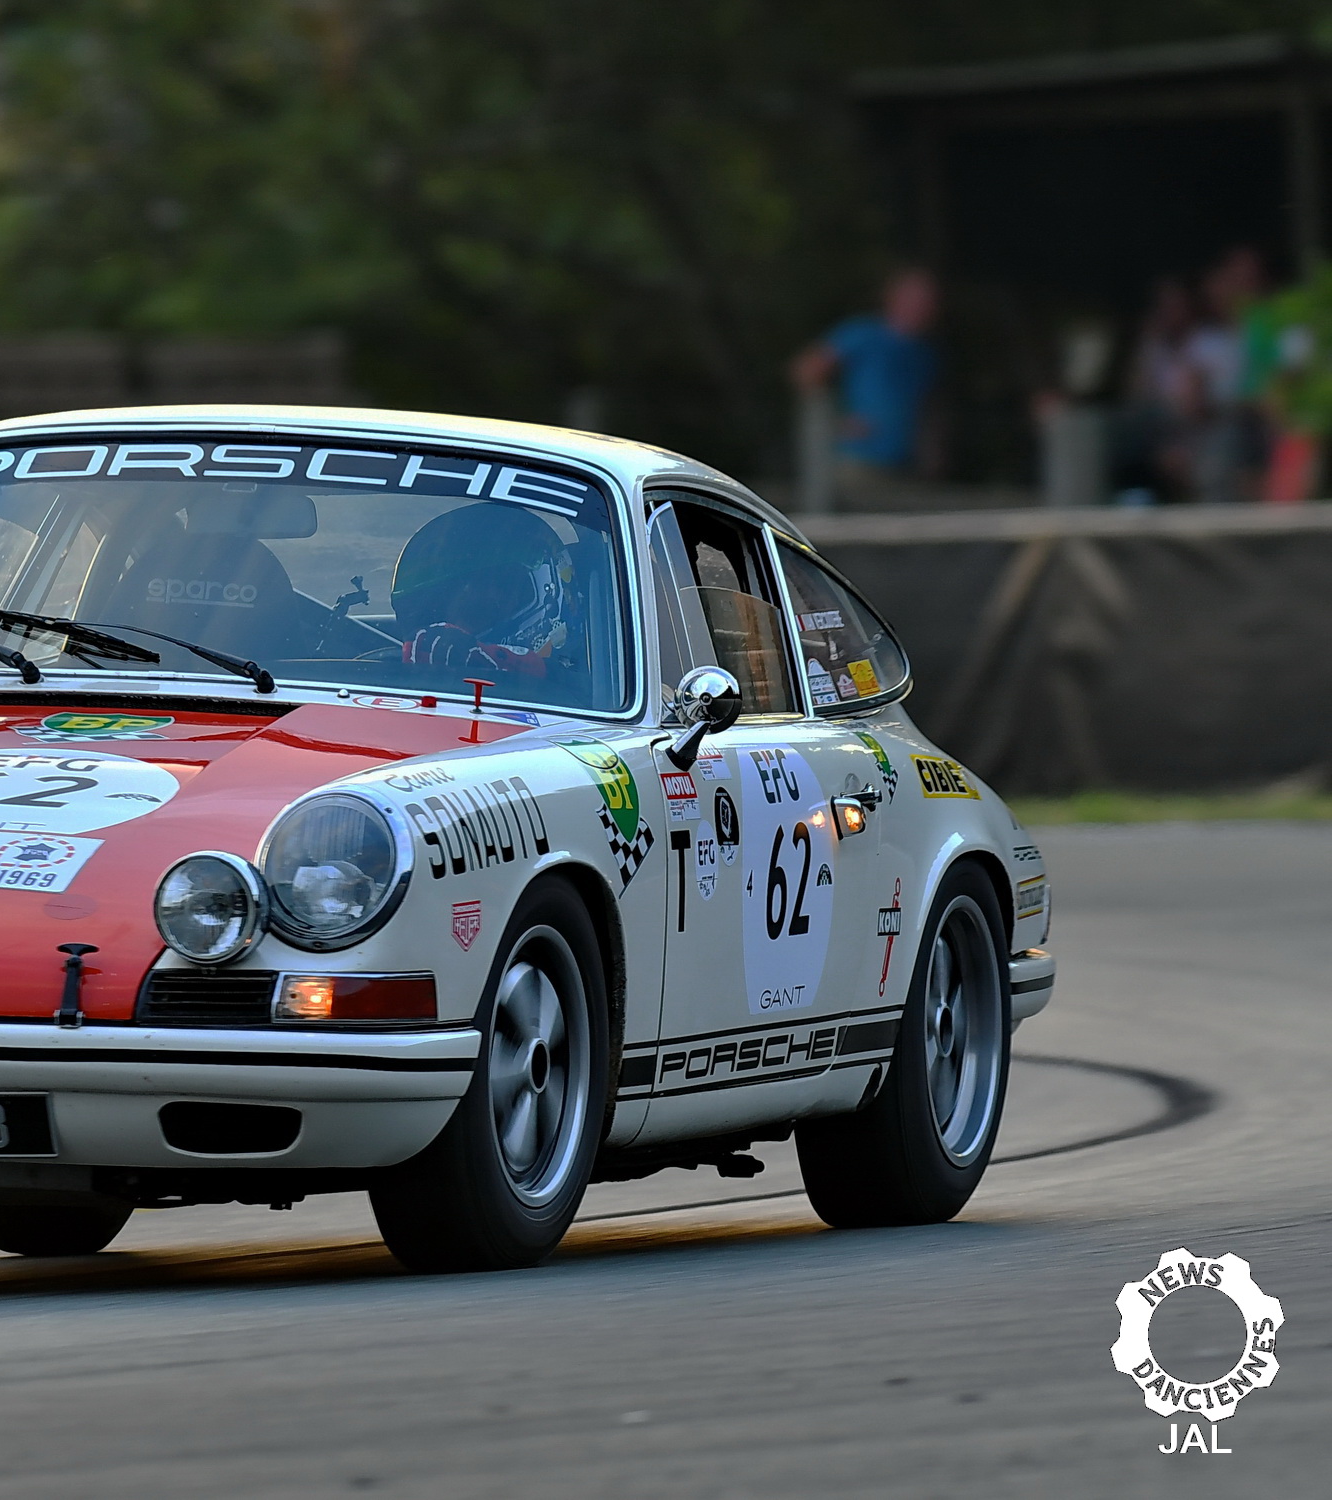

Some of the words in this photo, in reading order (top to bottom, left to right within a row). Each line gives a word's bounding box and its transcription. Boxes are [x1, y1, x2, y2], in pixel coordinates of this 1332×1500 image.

[147, 578, 257, 604] sparco
[57, 715, 158, 732] BP
[663, 774, 696, 797] MOTUL
[749, 748, 800, 804] EFG
[405, 775, 551, 881] SONAUTO
[697, 838, 716, 867] EFG
[670, 829, 692, 933] T
[766, 821, 813, 941] 62
[877, 909, 902, 934] KONI
[759, 985, 807, 1010] GANT
[658, 1026, 837, 1084] PORSCHE
